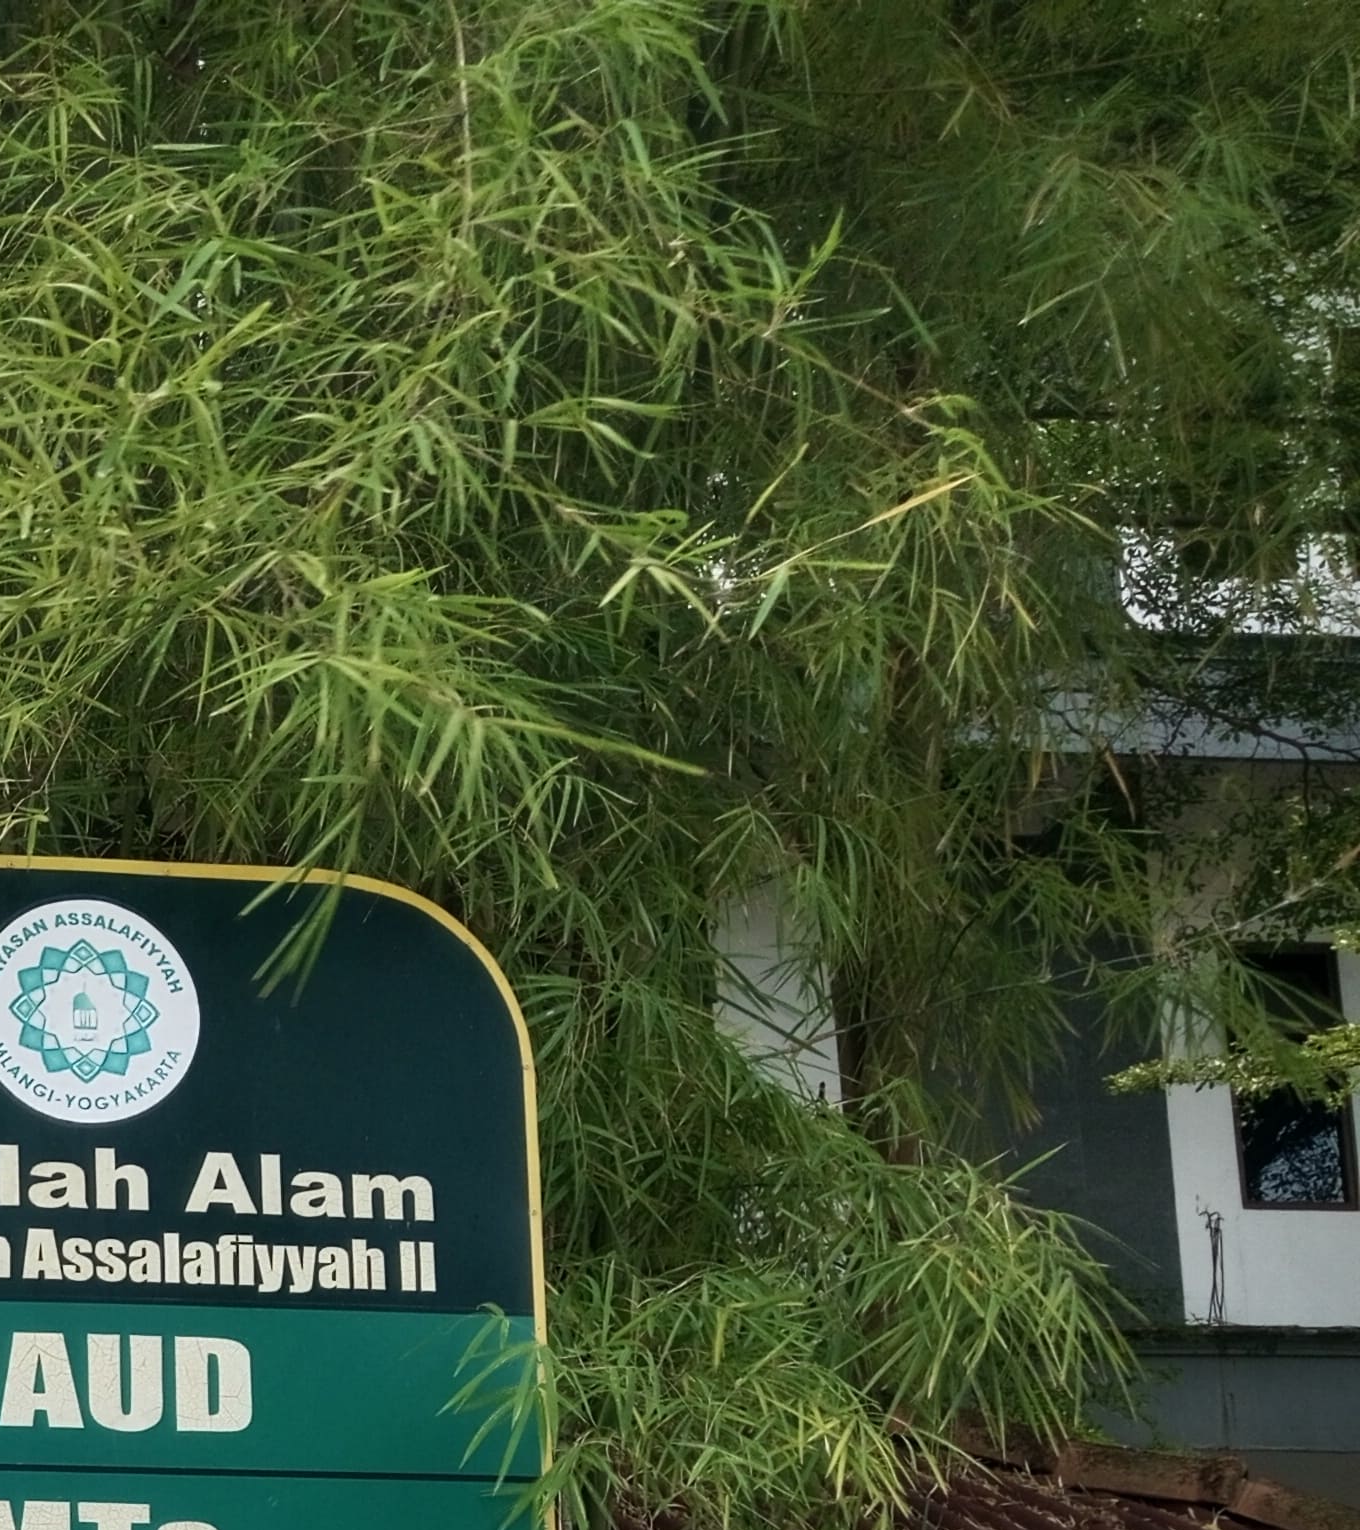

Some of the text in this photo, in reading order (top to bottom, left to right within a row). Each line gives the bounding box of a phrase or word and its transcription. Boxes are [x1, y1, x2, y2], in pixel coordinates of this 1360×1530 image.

[54, 911, 184, 994] ASSALAFIYYAH
[185, 1151, 436, 1222] Alam
[22, 1226, 386, 1294] Assalafiyyah
[399, 1240, 437, 1292] II
